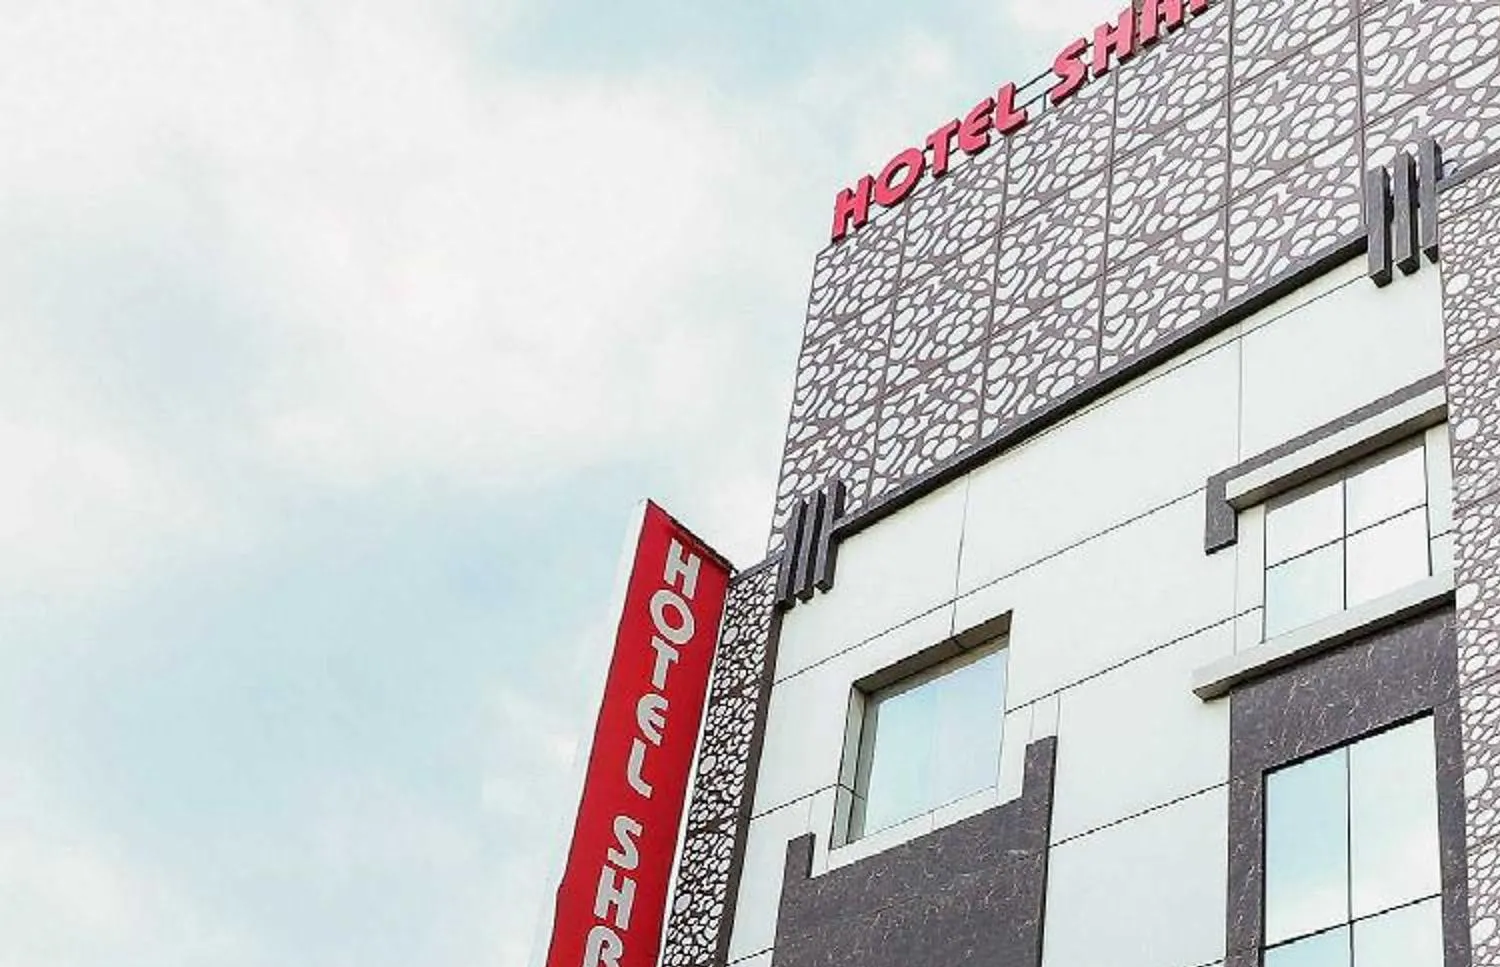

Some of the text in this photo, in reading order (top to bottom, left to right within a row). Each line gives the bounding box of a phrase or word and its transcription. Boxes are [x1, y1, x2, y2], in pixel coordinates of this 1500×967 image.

[831, 0, 1208, 244] HOTEL SHR
[625, 534, 700, 800] HOTEL
